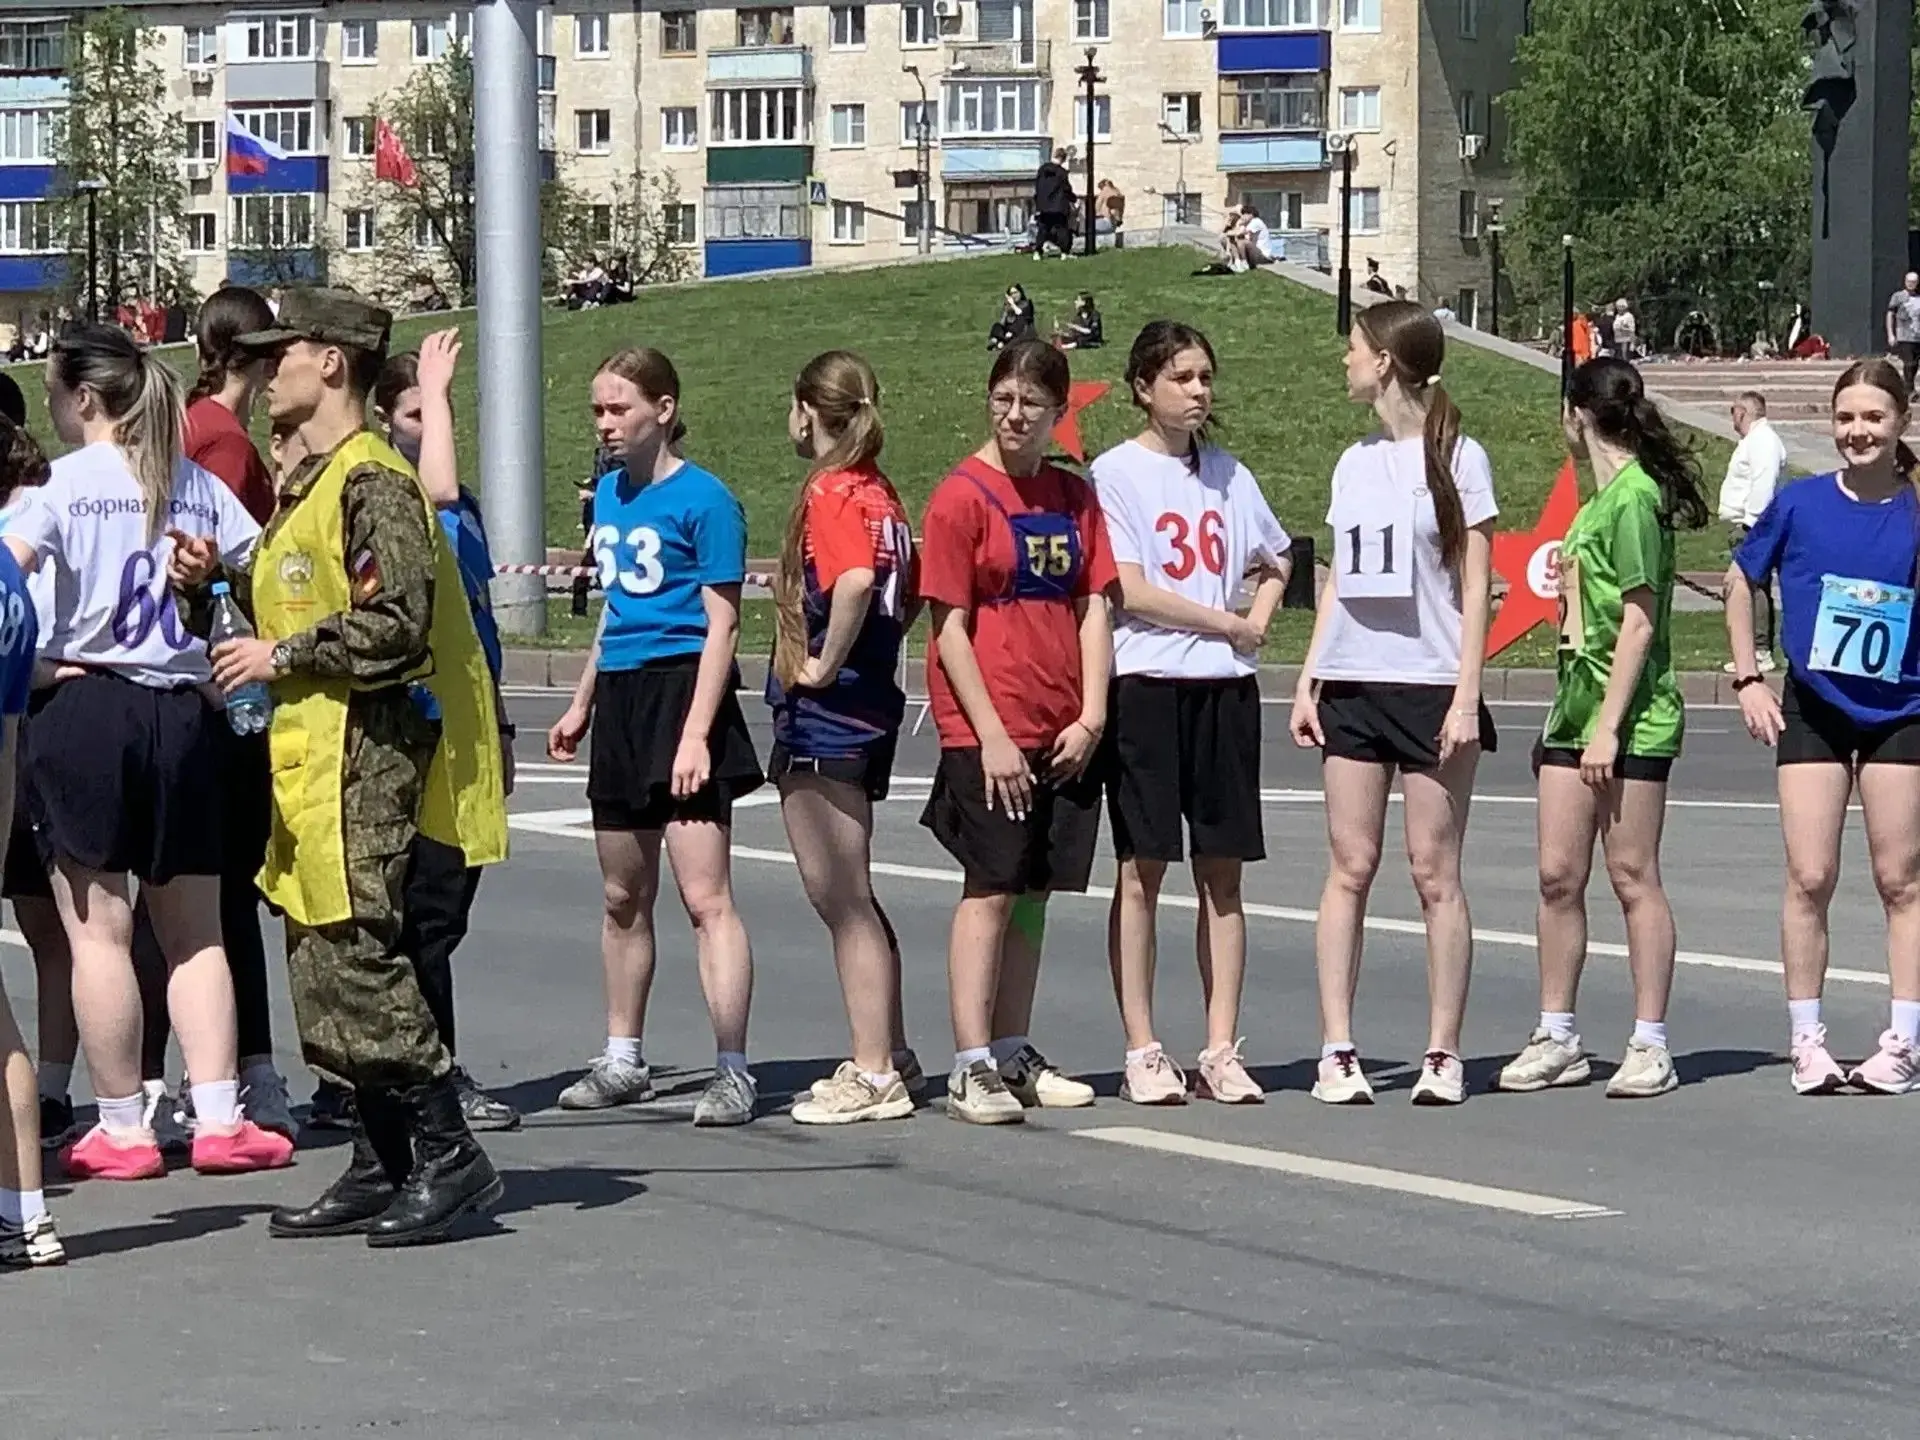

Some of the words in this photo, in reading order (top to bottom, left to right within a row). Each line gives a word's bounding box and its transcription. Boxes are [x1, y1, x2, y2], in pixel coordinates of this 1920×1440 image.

[593, 524, 664, 594] 63
[1024, 534, 1072, 577] 55
[1155, 510, 1227, 580] 36
[1344, 523, 1397, 575] 11
[1831, 614, 1891, 674] 70
